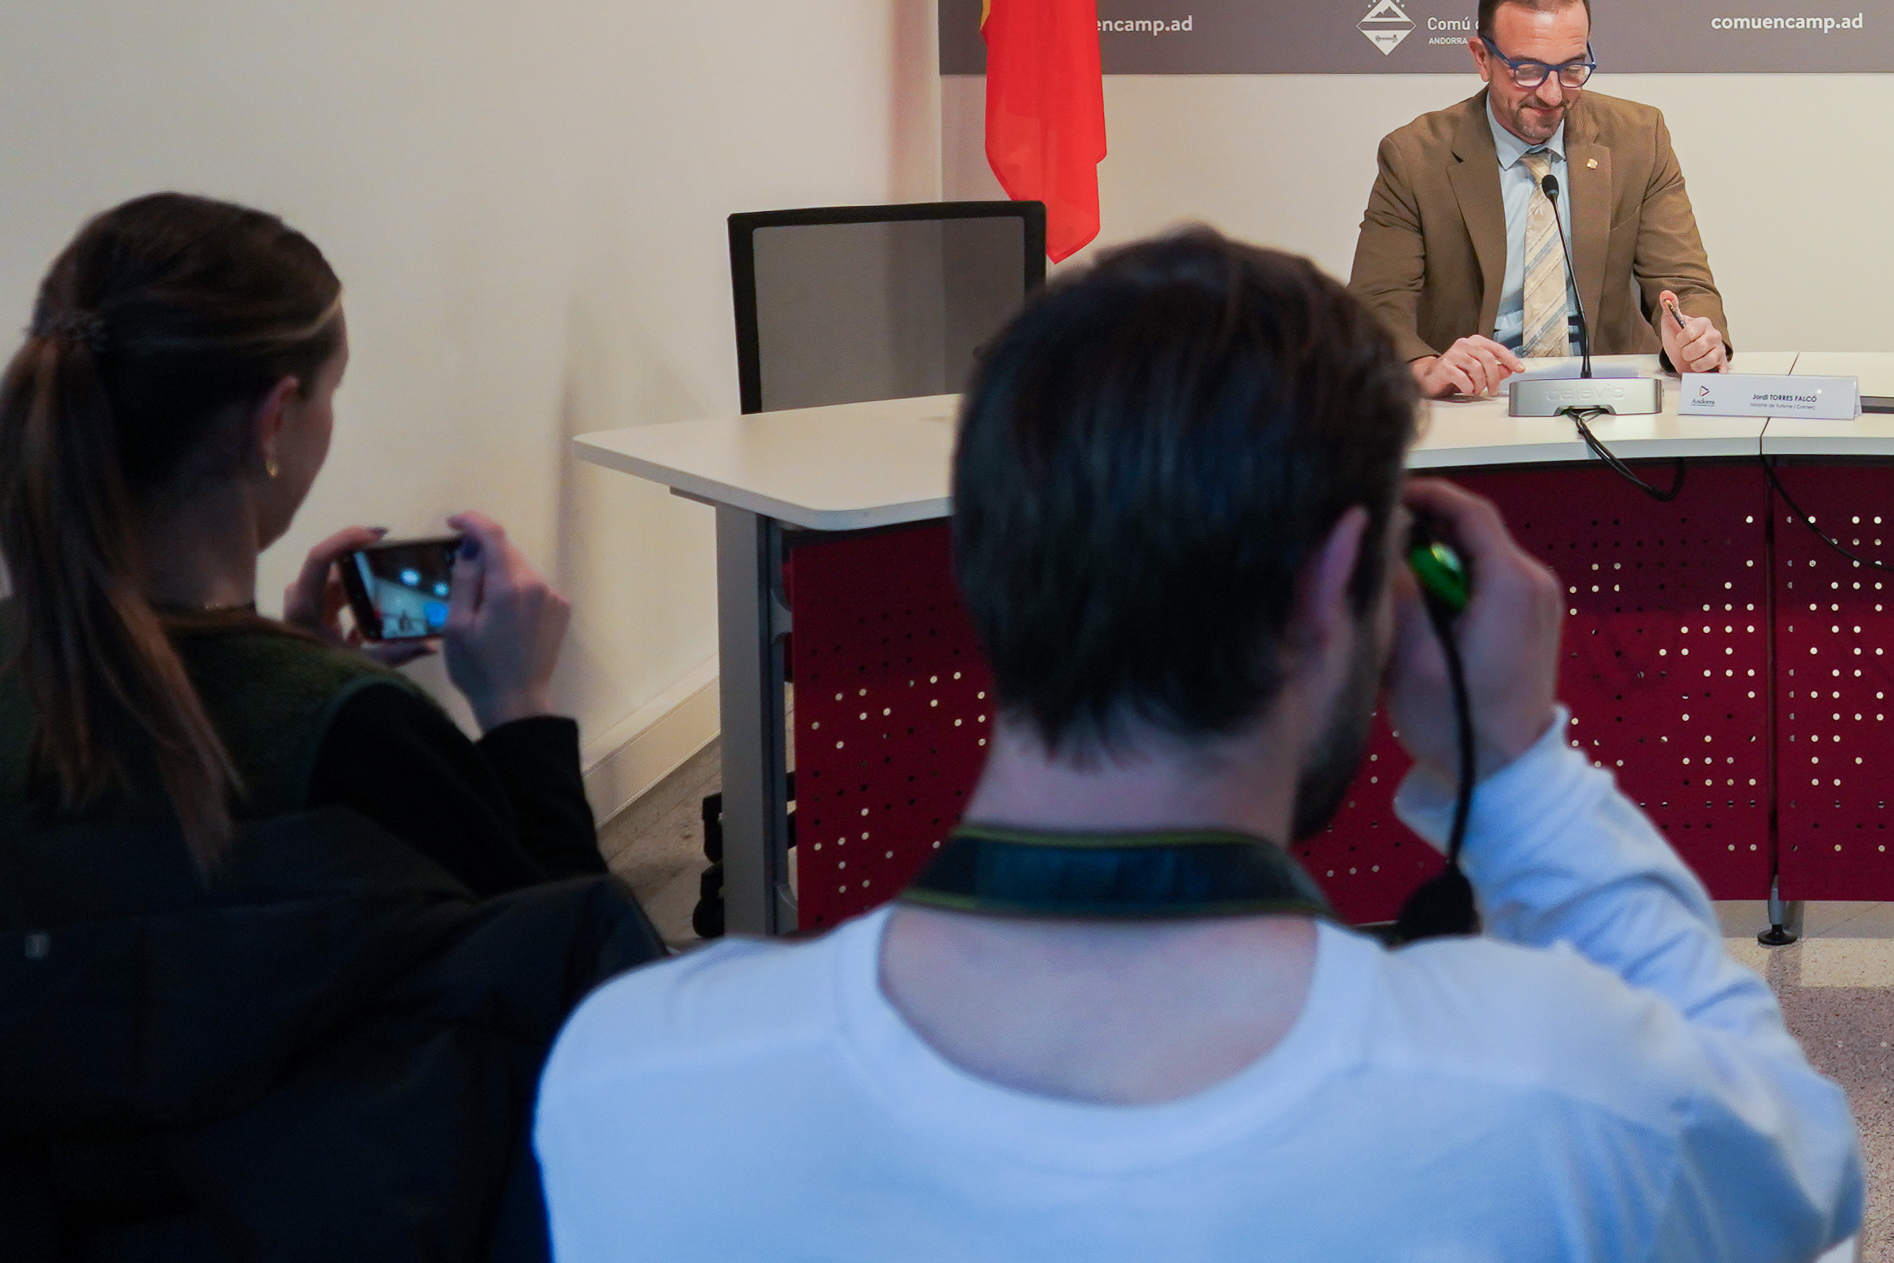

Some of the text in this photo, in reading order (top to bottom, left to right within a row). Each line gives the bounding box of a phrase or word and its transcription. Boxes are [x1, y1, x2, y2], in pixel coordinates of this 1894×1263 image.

[1427, 16, 1471, 31] Comú
[1711, 12, 1863, 34] comuencamp.ad
[1428, 37, 1469, 45] ANDORRA
[1769, 394, 1793, 402] TORRES
